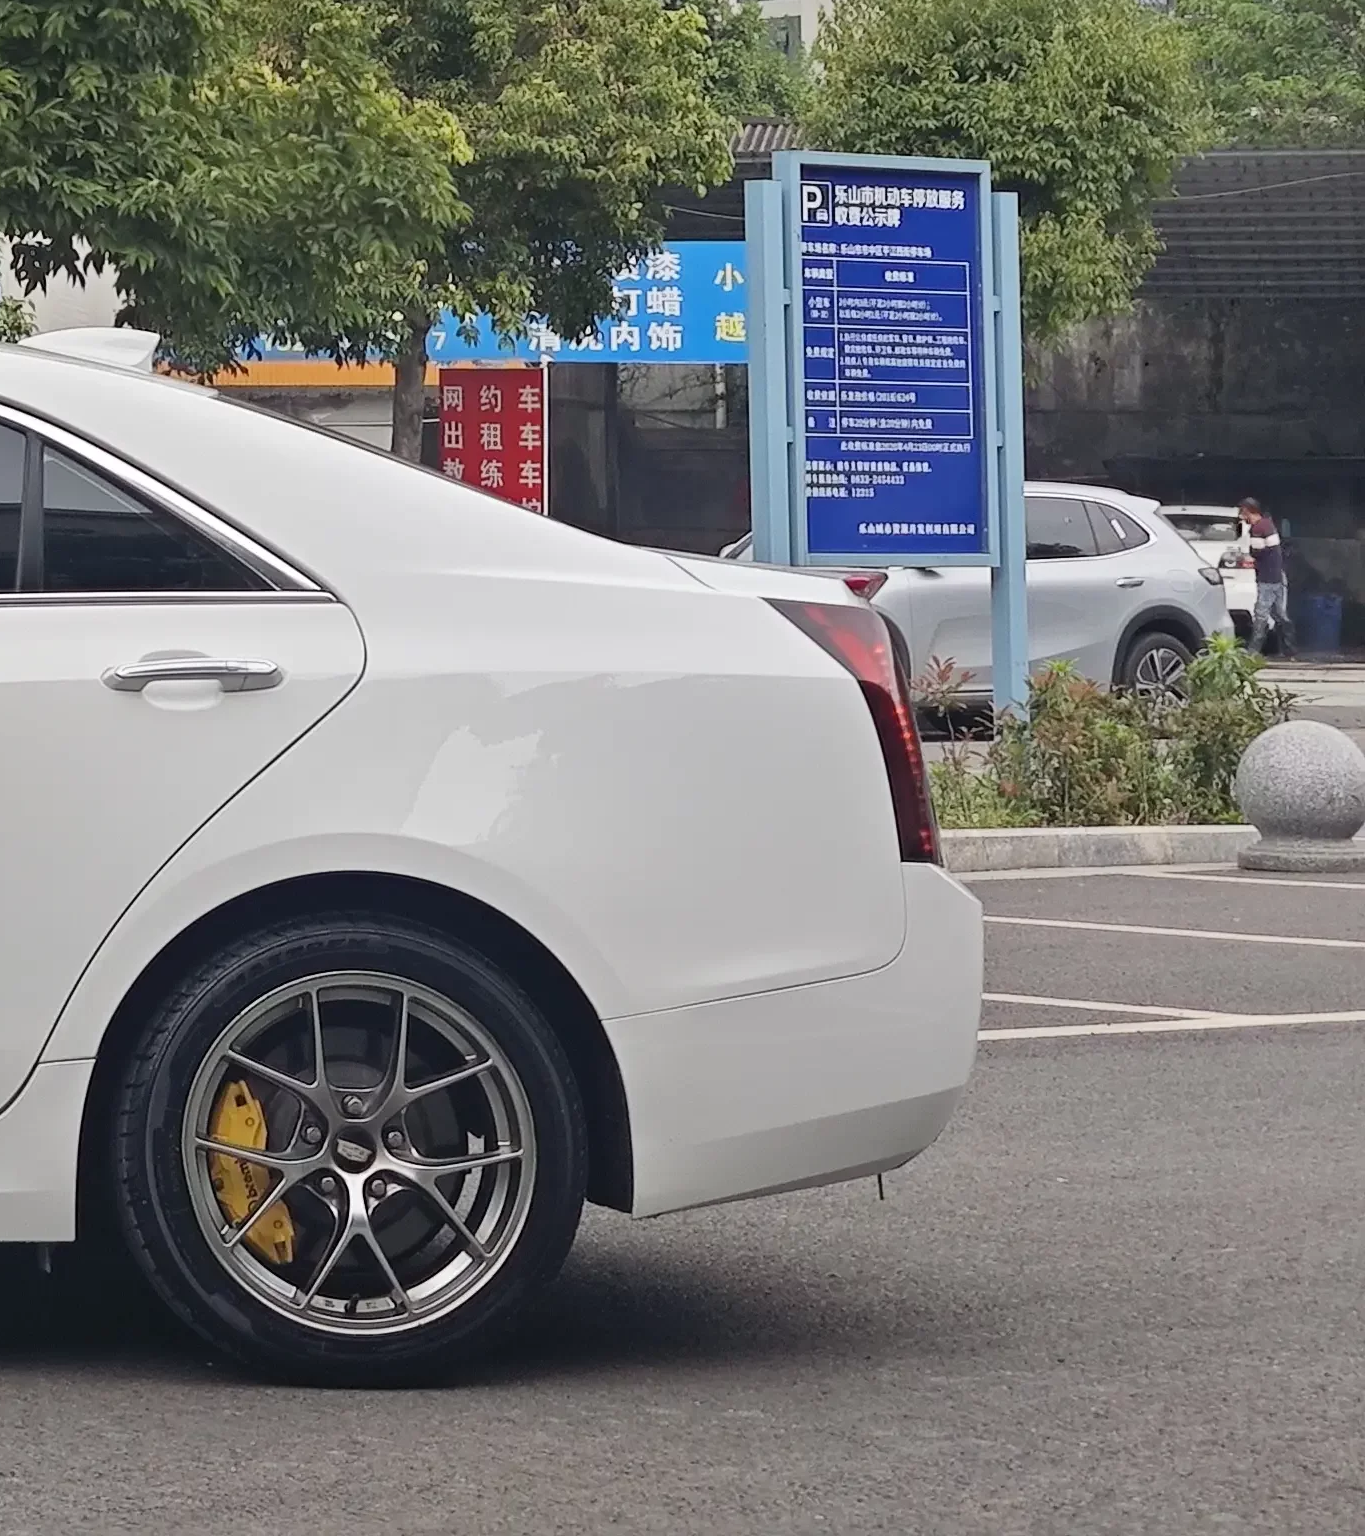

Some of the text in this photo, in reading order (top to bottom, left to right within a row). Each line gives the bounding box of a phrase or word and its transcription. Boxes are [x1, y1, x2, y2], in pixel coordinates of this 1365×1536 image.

[834, 185, 965, 210] 乐山市机动车停放服务
[834, 206, 901, 228] 收费公示牌
[714, 262, 745, 292] 小
[714, 311, 746, 342] 越
[443, 385, 541, 413] 网约车
[443, 421, 542, 451] 出租车
